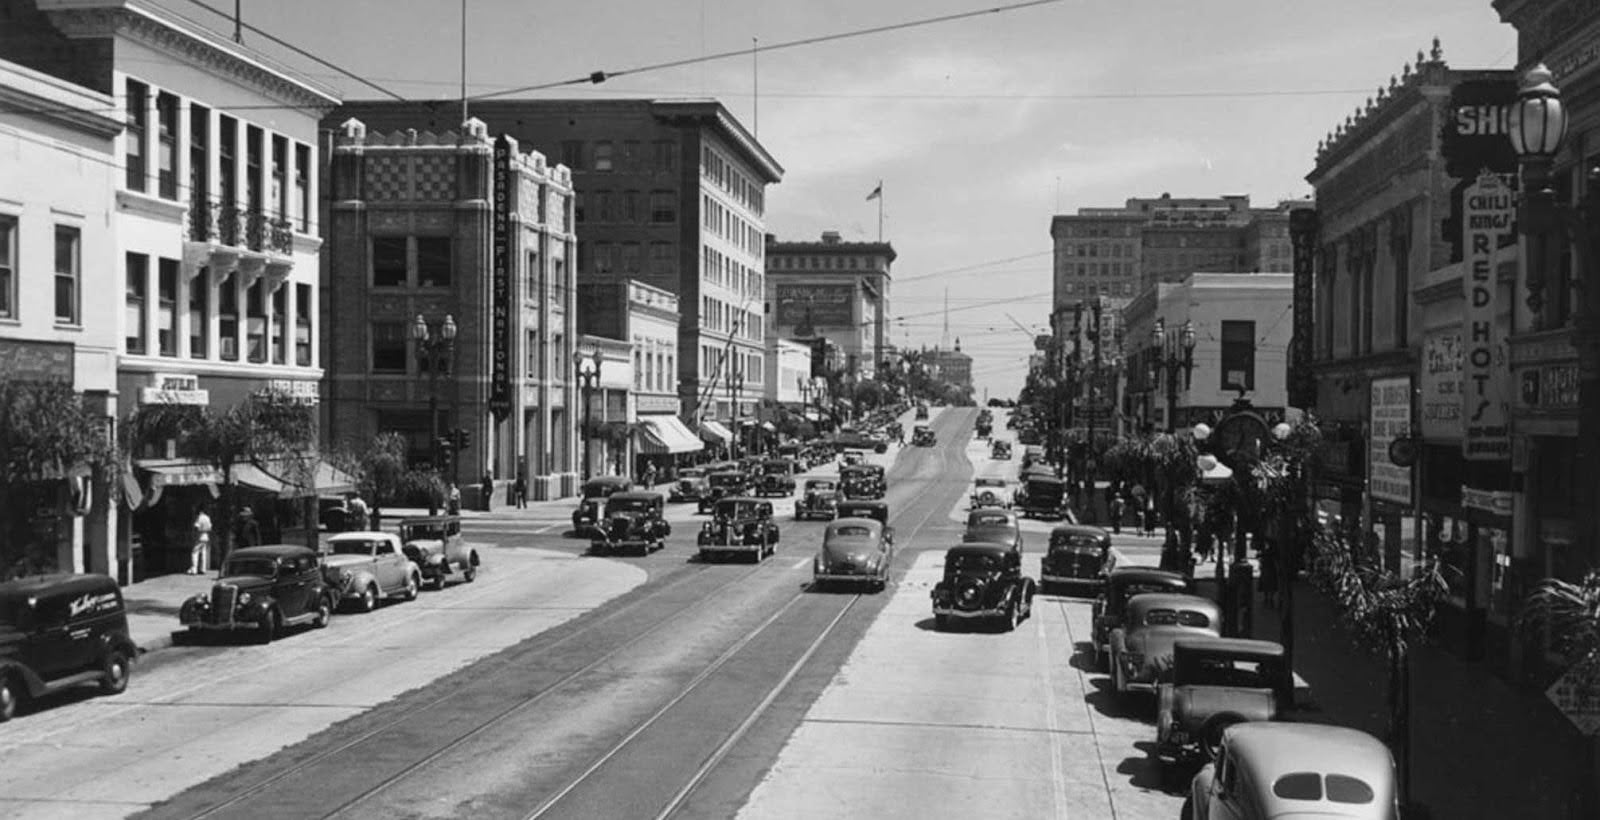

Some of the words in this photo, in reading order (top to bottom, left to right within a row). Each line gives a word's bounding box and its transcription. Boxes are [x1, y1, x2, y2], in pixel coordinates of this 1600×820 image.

[1469, 195, 1508, 211] CHILI
[1469, 214, 1509, 229] KINGS
[1473, 233, 1490, 308] RED
[495, 306, 505, 393] NATIONAL
[1471, 322, 1492, 421] HOTS
